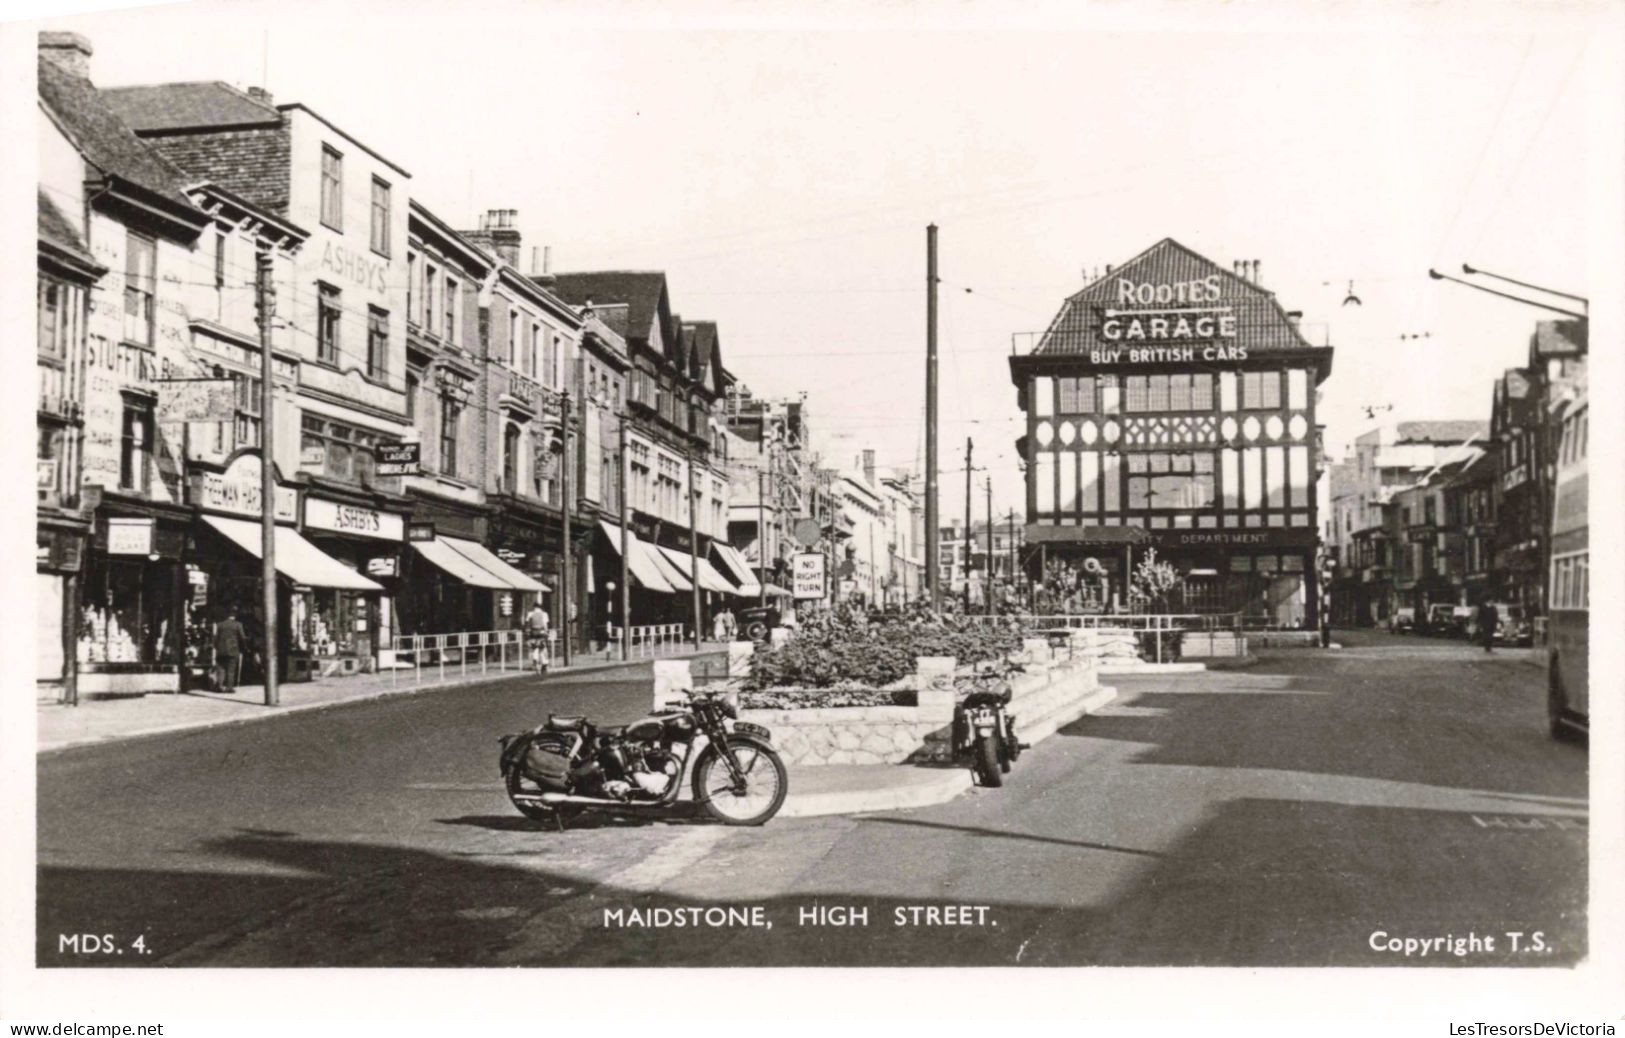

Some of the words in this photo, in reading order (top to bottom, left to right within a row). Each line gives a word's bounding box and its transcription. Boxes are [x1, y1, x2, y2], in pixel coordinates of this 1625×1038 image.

[1118, 275, 1221, 305] ROOTES
[1103, 316, 1237, 339] GARAGE
[1091, 350, 1121, 364] BUY
[1129, 348, 1194, 363] BRITISH
[1203, 347, 1248, 361] CARS
[1180, 534, 1268, 544] DEPARTMENT
[796, 572, 821, 580] RIGHT
[797, 584, 821, 592] TURN
